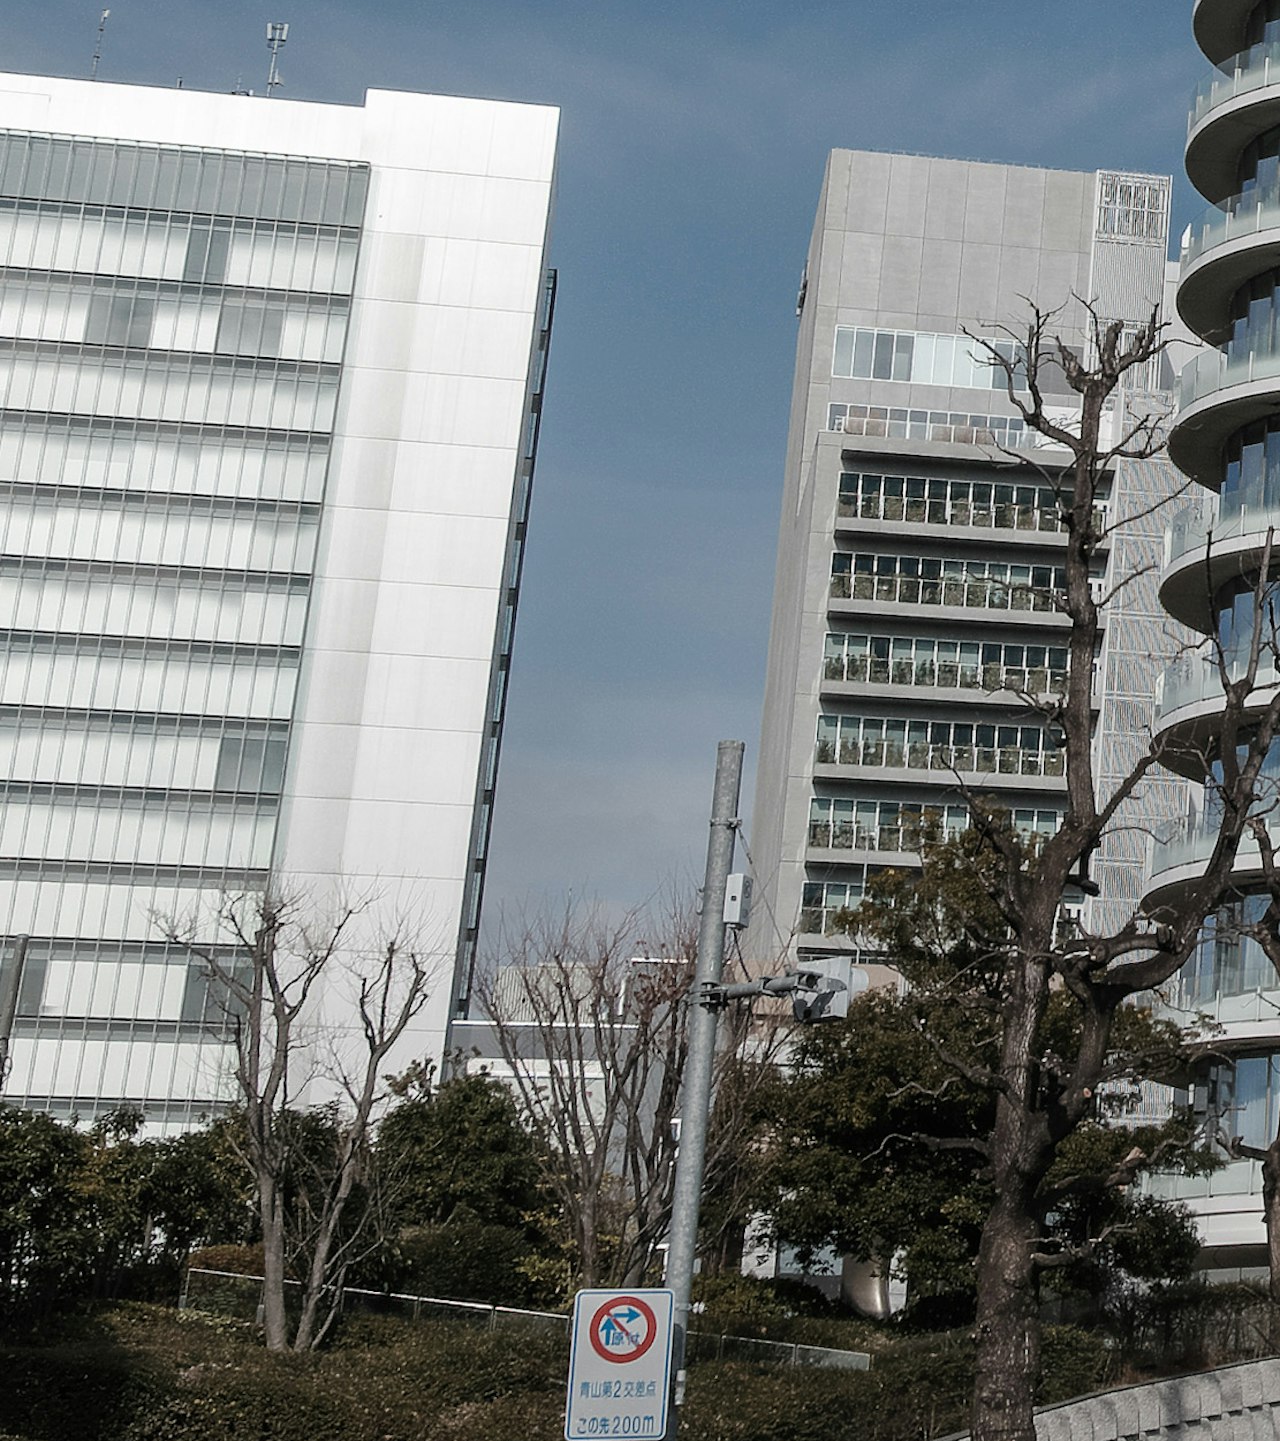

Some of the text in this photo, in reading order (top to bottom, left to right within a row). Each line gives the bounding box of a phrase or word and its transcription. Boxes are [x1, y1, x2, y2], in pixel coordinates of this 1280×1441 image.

[580, 1380, 656, 1397] 青山第2交差点
